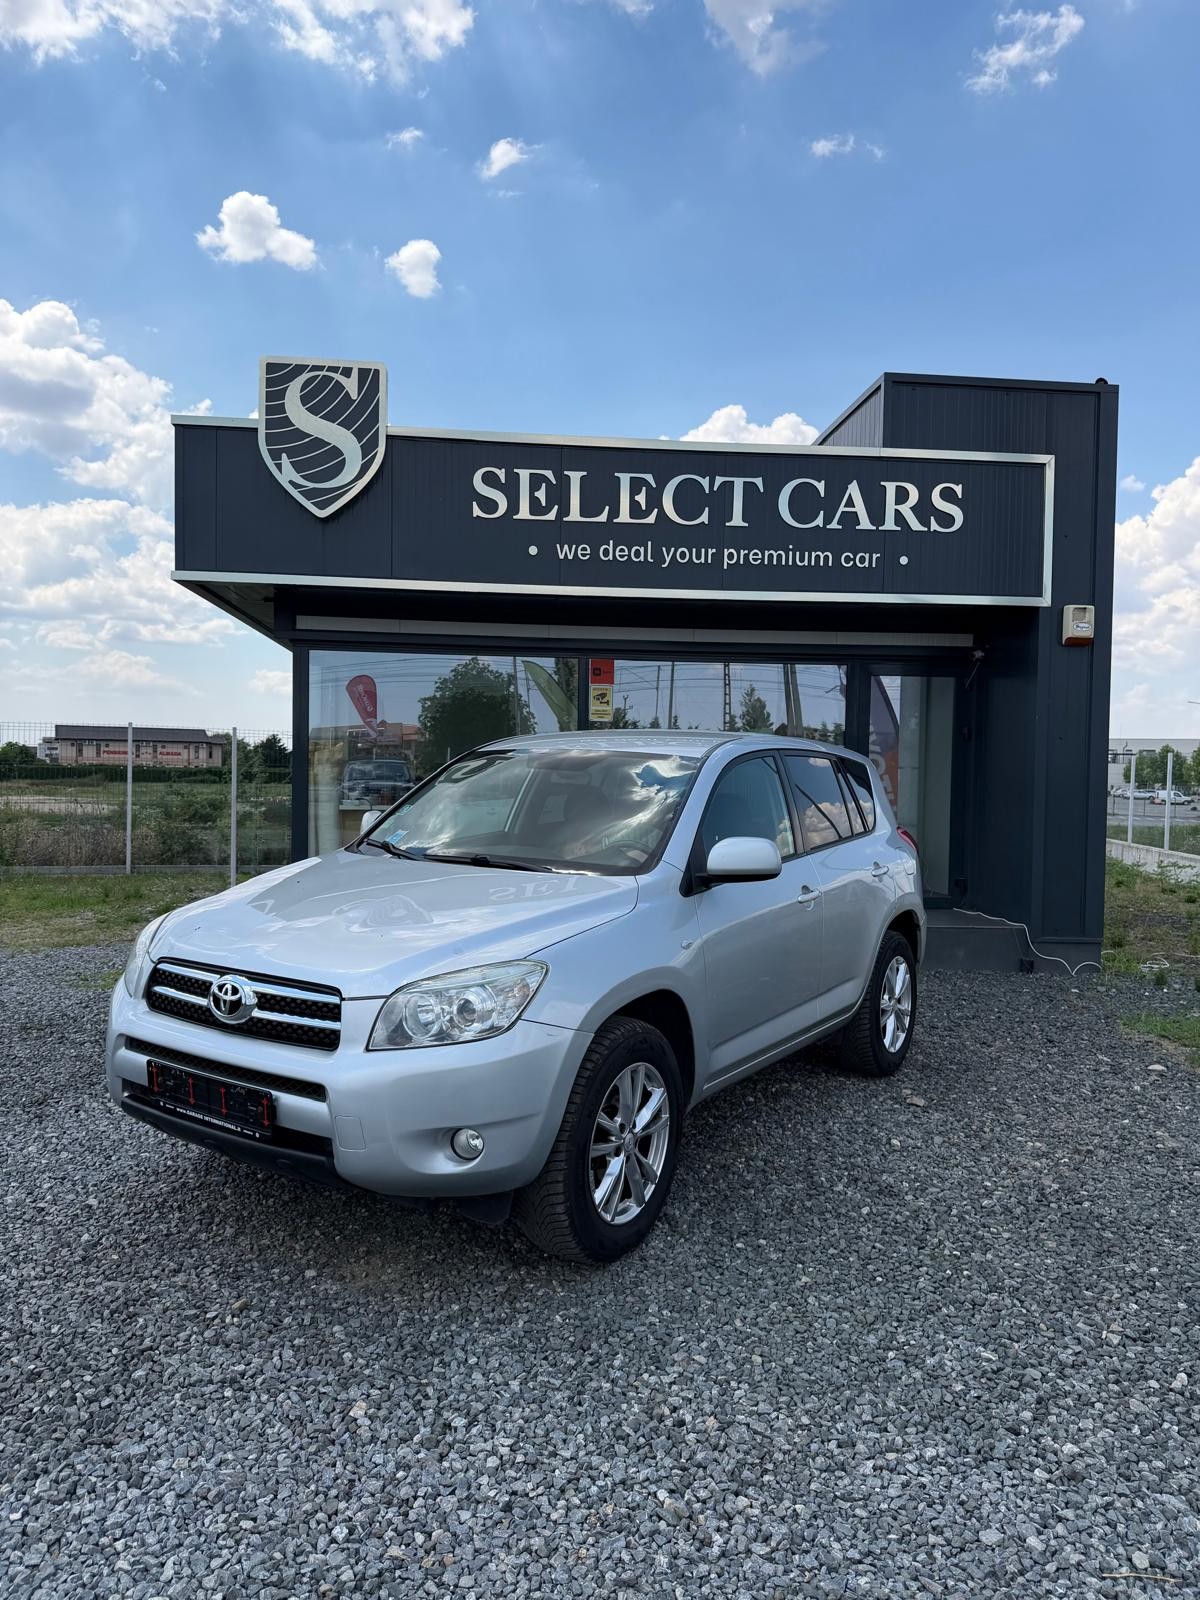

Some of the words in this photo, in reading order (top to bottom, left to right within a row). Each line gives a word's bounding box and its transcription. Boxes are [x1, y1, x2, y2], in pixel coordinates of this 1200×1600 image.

[472, 466, 764, 527] SELECT
[777, 476, 964, 534] CARS
[556, 543, 591, 562] we
[599, 539, 654, 564] deal
[661, 546, 717, 570] your
[723, 548, 833, 570] premium
[840, 551, 881, 568] car
